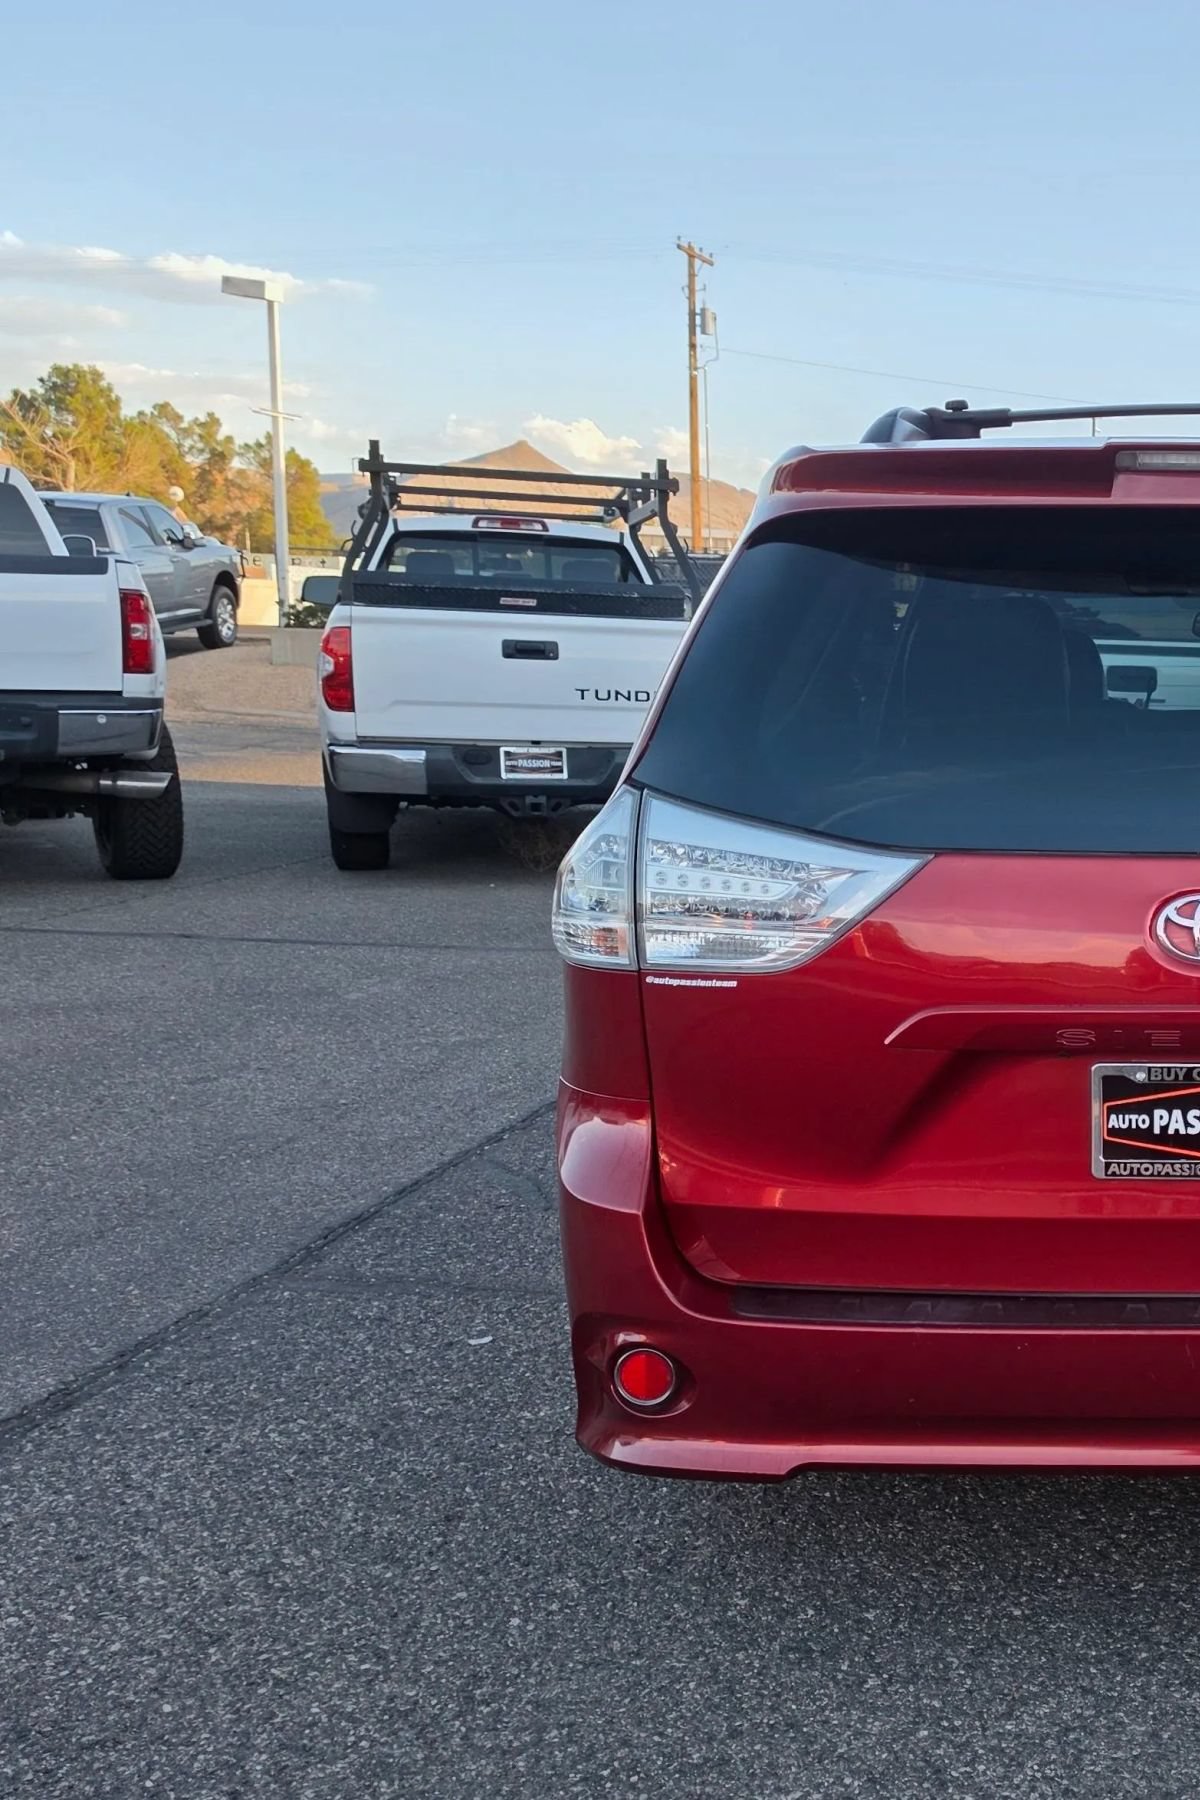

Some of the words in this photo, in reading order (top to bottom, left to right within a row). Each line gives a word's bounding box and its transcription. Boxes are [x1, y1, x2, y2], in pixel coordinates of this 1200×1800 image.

[574, 688, 656, 702] TUND
[518, 760, 551, 768] PASSION
[645, 975, 738, 987] @autopassionteam
[1150, 1068, 1187, 1081] BUY
[1108, 1114, 1149, 1129] AUTO
